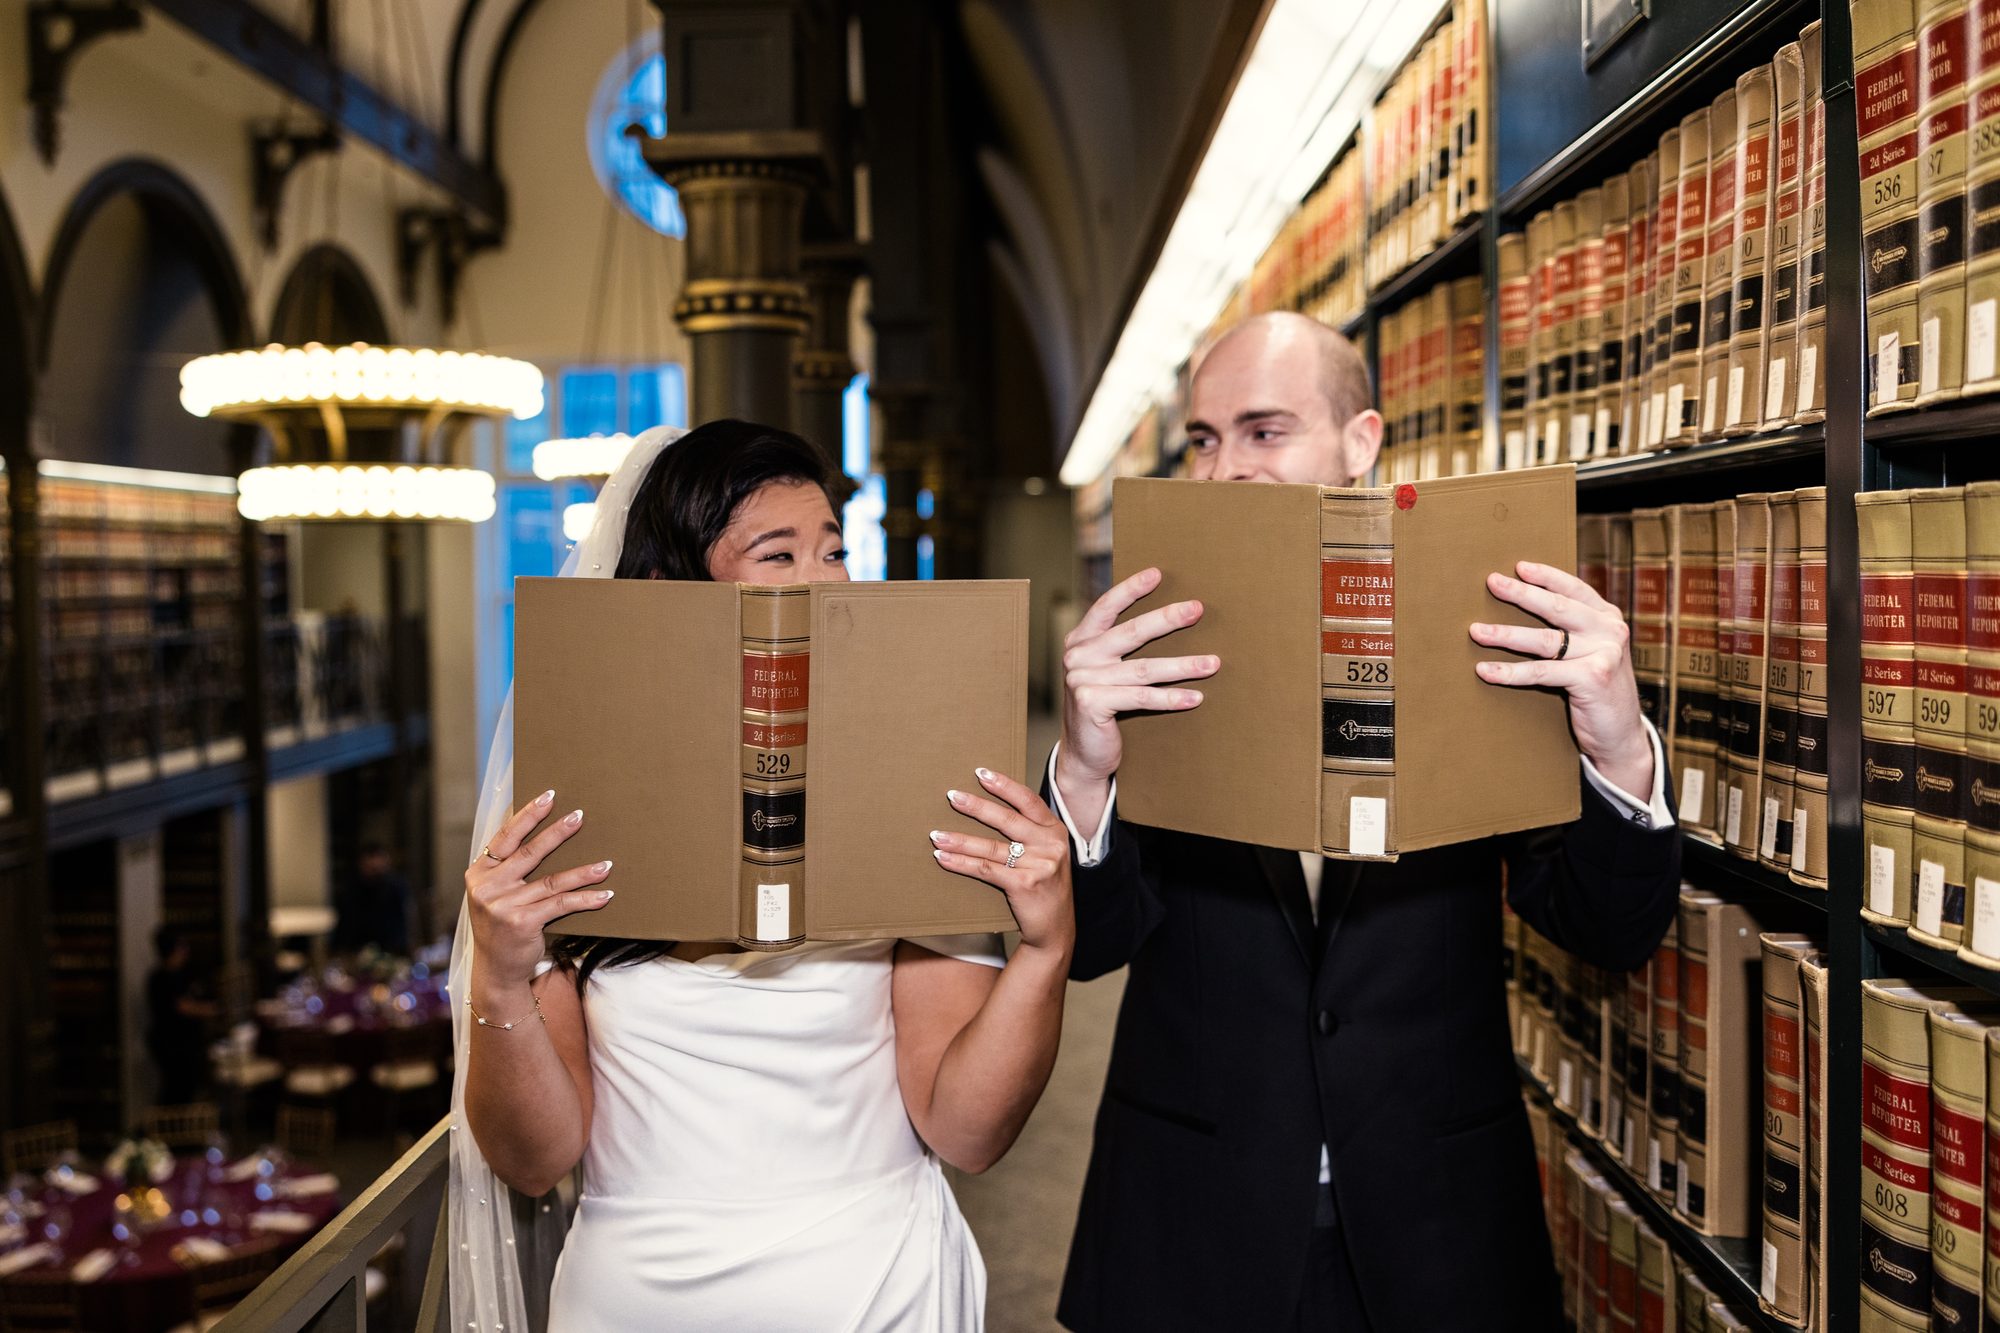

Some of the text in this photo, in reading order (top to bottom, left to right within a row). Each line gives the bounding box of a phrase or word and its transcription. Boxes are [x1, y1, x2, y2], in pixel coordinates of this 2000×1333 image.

[1867, 70, 1905, 99] FEDERAL
[1865, 88, 1908, 120] REPORTER
[1869, 146, 1906, 170] 2d Series
[1874, 174, 1901, 205] 586
[1336, 592, 1393, 606] REPORTE
[1863, 594, 1902, 608] FEDERAL
[1918, 593, 1956, 609] FEDERAL
[1973, 595, 2000, 611] FEDER
[1916, 614, 1959, 630] REPORTER
[1341, 638, 1355, 649] 2d
[754, 669, 797, 683] FEDERAL
[1347, 661, 1389, 683] 528
[1771, 665, 1787, 688] 516
[1800, 669, 1813, 692] 17
[1874, 667, 1902, 681] Series
[1918, 668, 1956, 685] 2d Series
[751, 686, 800, 699] REPORTER
[1973, 675, 2000, 692] 2d Ser
[1868, 690, 1896, 717] 597
[1921, 697, 1950, 724] 599
[1979, 704, 2000, 733] 59
[753, 730, 796, 743] 2d Series
[756, 753, 791, 775] 529
[1873, 1084, 1917, 1114] FEDERAL
[1871, 1102, 1922, 1135] REPORTER
[1873, 1155, 1916, 1184] 2d Series
[1875, 1183, 1908, 1218] 608
